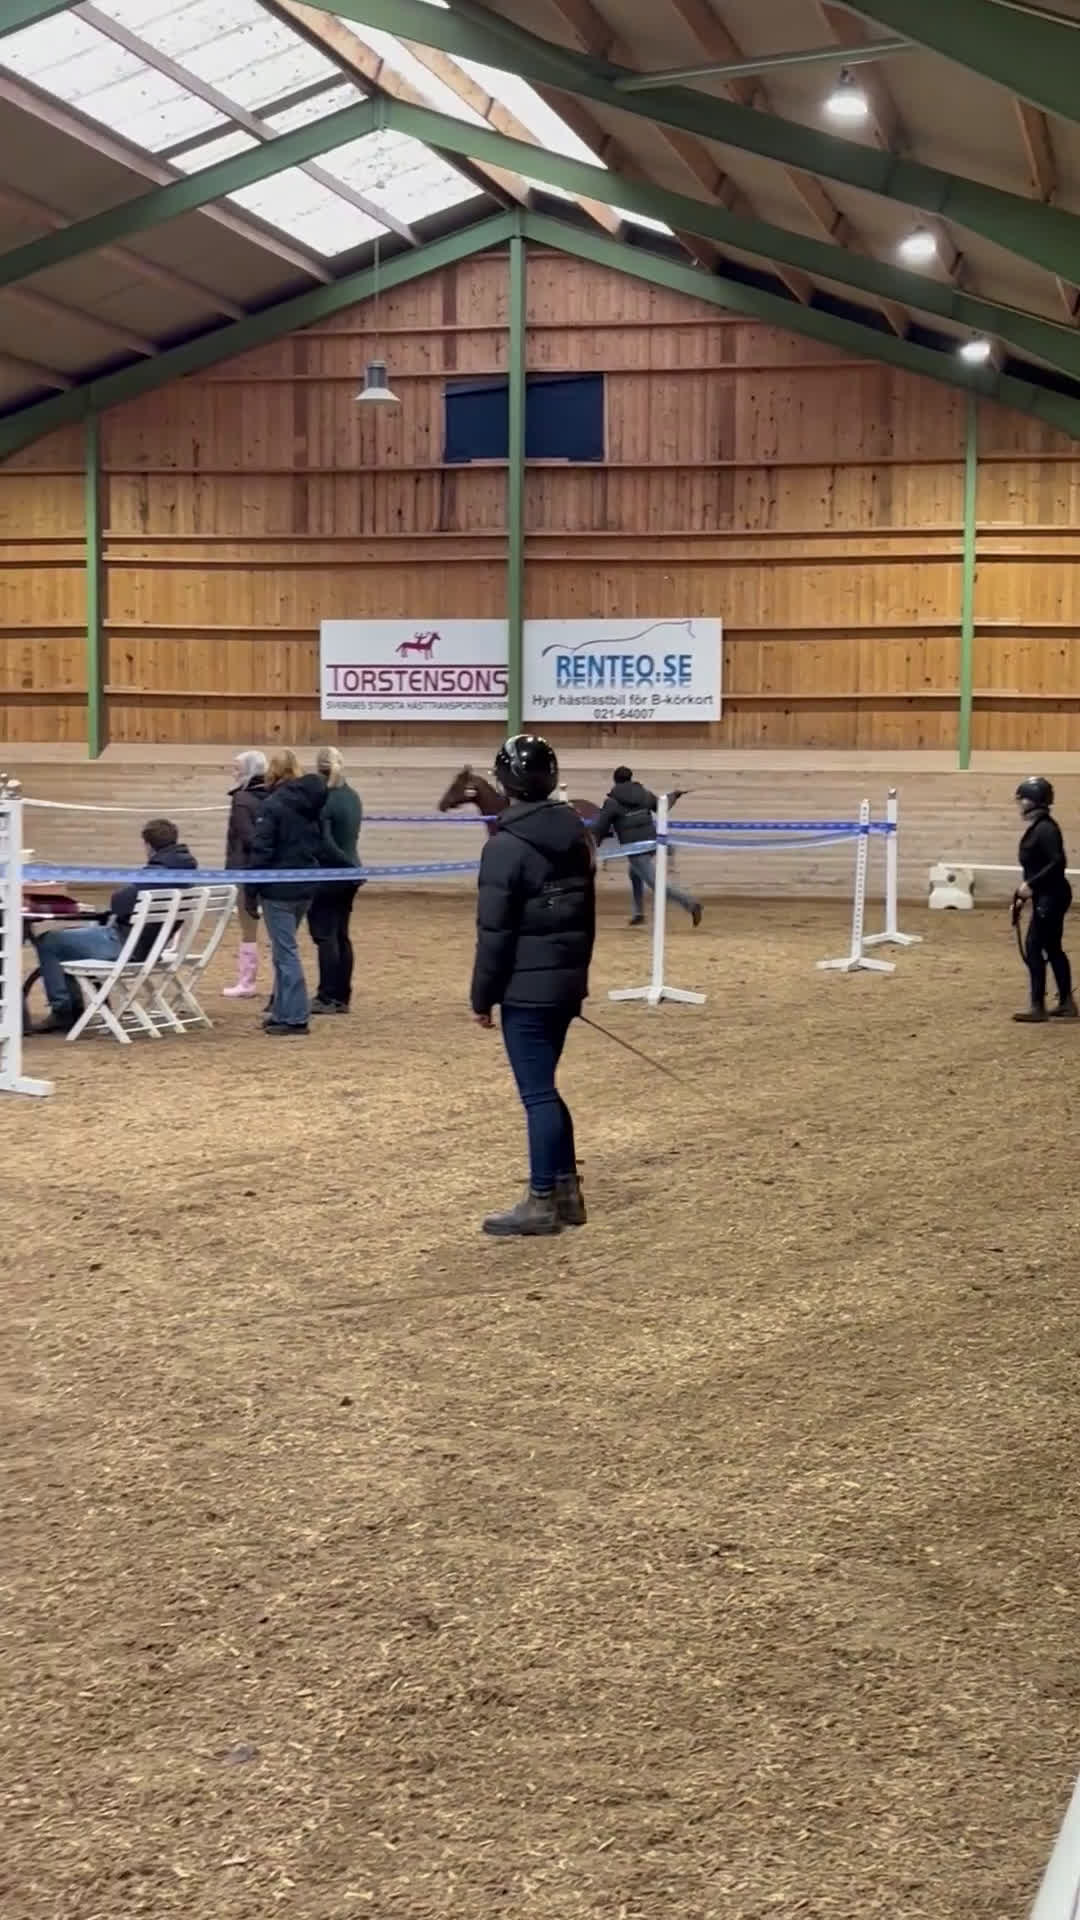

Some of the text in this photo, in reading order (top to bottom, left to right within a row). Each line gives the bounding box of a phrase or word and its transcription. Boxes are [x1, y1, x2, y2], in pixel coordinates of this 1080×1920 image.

[555, 654, 691, 677] RENTEO.SE
[329, 666, 508, 695] TORSTENSONS
[532, 694, 713, 708] Hyr hästlastbil för B-körkort
[594, 708, 655, 719] 021-64007
